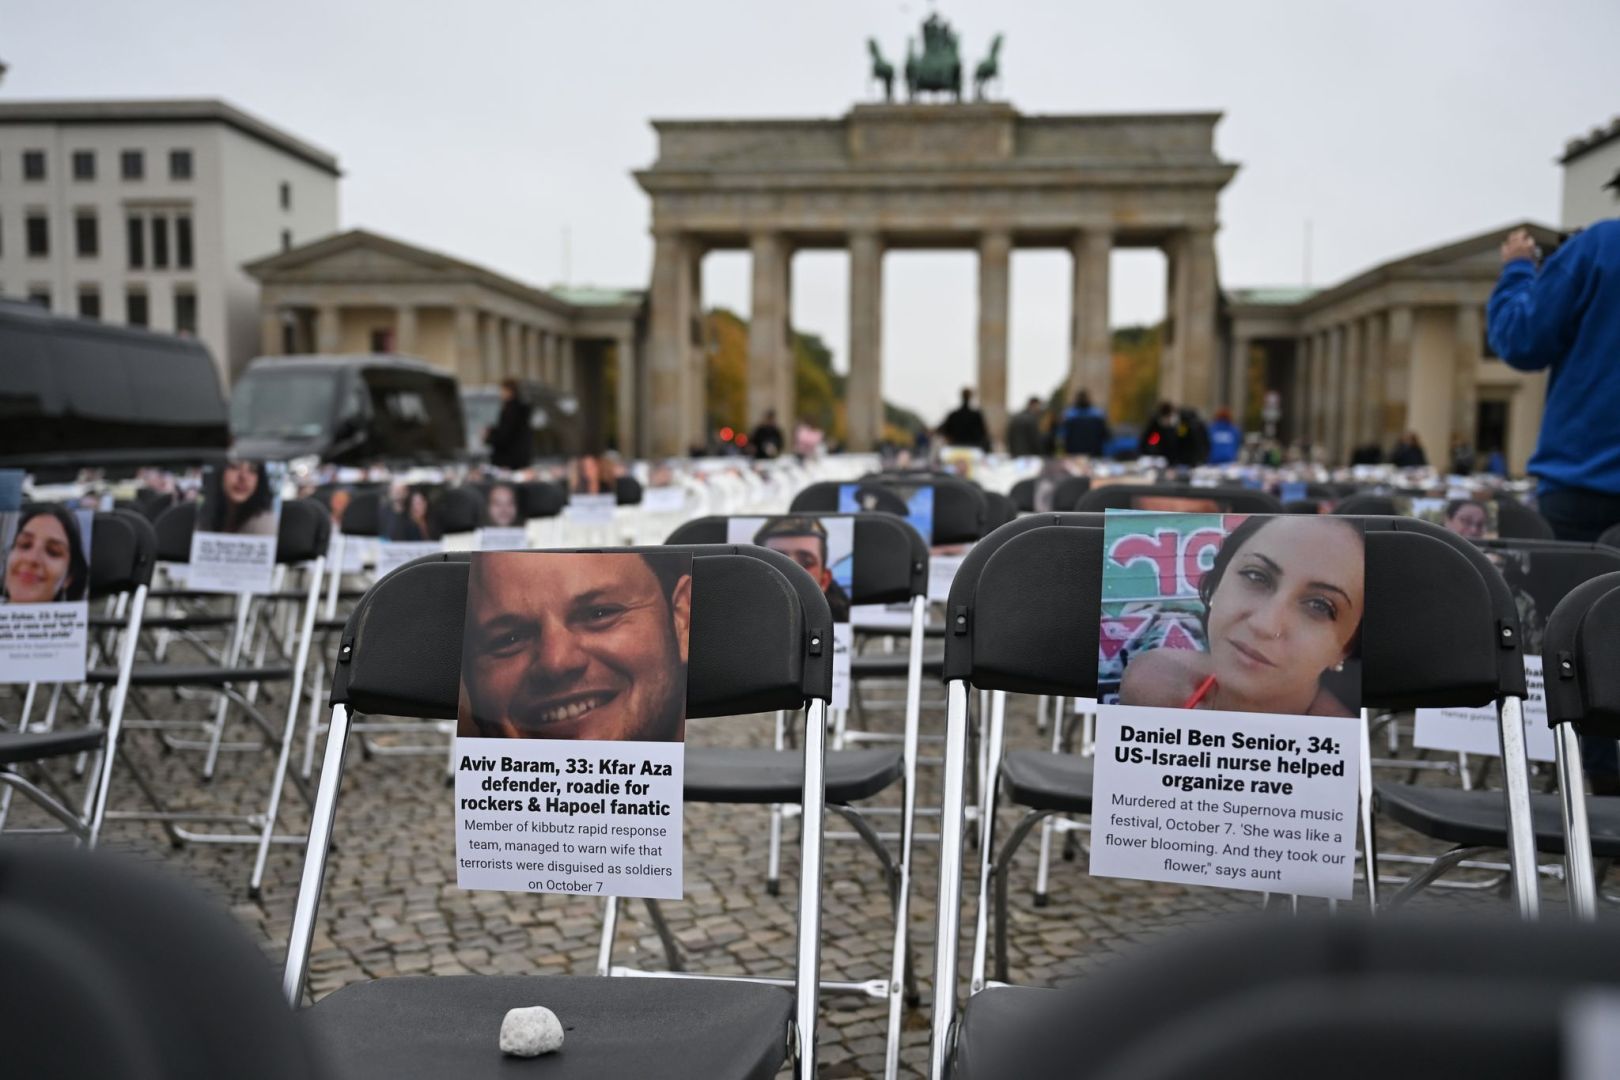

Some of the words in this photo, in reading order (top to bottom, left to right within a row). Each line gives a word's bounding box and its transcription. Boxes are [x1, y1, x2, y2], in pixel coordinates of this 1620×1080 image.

[1120, 725, 1181, 745] Daniel
[1188, 730, 1225, 747] Ben
[1232, 732, 1300, 755] Senior,
[1307, 737, 1340, 754] 34:
[459, 756, 496, 771] Aviv
[501, 757, 560, 775] Baram,
[565, 759, 593, 774] 33:
[599, 759, 635, 774] Kfar
[640, 761, 672, 776] Aza
[1114, 747, 1211, 768] US-Israeli
[1217, 757, 1271, 771] nurse
[1277, 758, 1345, 779] helped
[481, 777, 561, 795] defender,
[566, 779, 620, 794] roadie
[625, 781, 650, 795] for
[1162, 775, 1244, 792] organize
[1250, 780, 1293, 795] rave
[461, 796, 523, 811] rockers
[528, 798, 541, 812] &
[546, 798, 605, 816] Hapoel
[610, 800, 670, 815] fanatic
[1111, 794, 1176, 810] Murdered
[1180, 798, 1193, 810] at
[1197, 799, 1219, 812] the
[1223, 802, 1296, 818] Supernova
[1300, 807, 1343, 821] music
[464, 820, 513, 831] Member
[516, 821, 528, 832] of
[532, 822, 574, 834] kibbutz
[579, 824, 608, 837] rapid
[611, 826, 667, 838] response
[1110, 814, 1162, 830] festival,
[1166, 818, 1220, 834] October
[1273, 828, 1301, 840] was
[1306, 829, 1330, 841] like
[1334, 833, 1342, 843] a
[469, 840, 501, 852] team,
[505, 842, 559, 855] managed
[563, 843, 574, 853] to
[578, 844, 607, 854] warn
[610, 844, 635, 855] wife
[639, 846, 662, 856] that
[1105, 834, 1147, 848] flower
[1151, 838, 1218, 856] blooming.
[1223, 844, 1249, 857] And
[1254, 846, 1283, 862] they
[1287, 850, 1318, 862] took
[1322, 853, 1346, 864] our
[460, 859, 512, 870] terrorists
[516, 862, 544, 871] were
[548, 861, 604, 875] disguised
[608, 864, 621, 874] as
[626, 864, 672, 876] soldiers
[1215, 864, 1246, 878] says
[1251, 867, 1281, 880] aunt
[529, 880, 543, 889] on
[546, 880, 592, 892] October
[596, 882, 603, 892] 7
